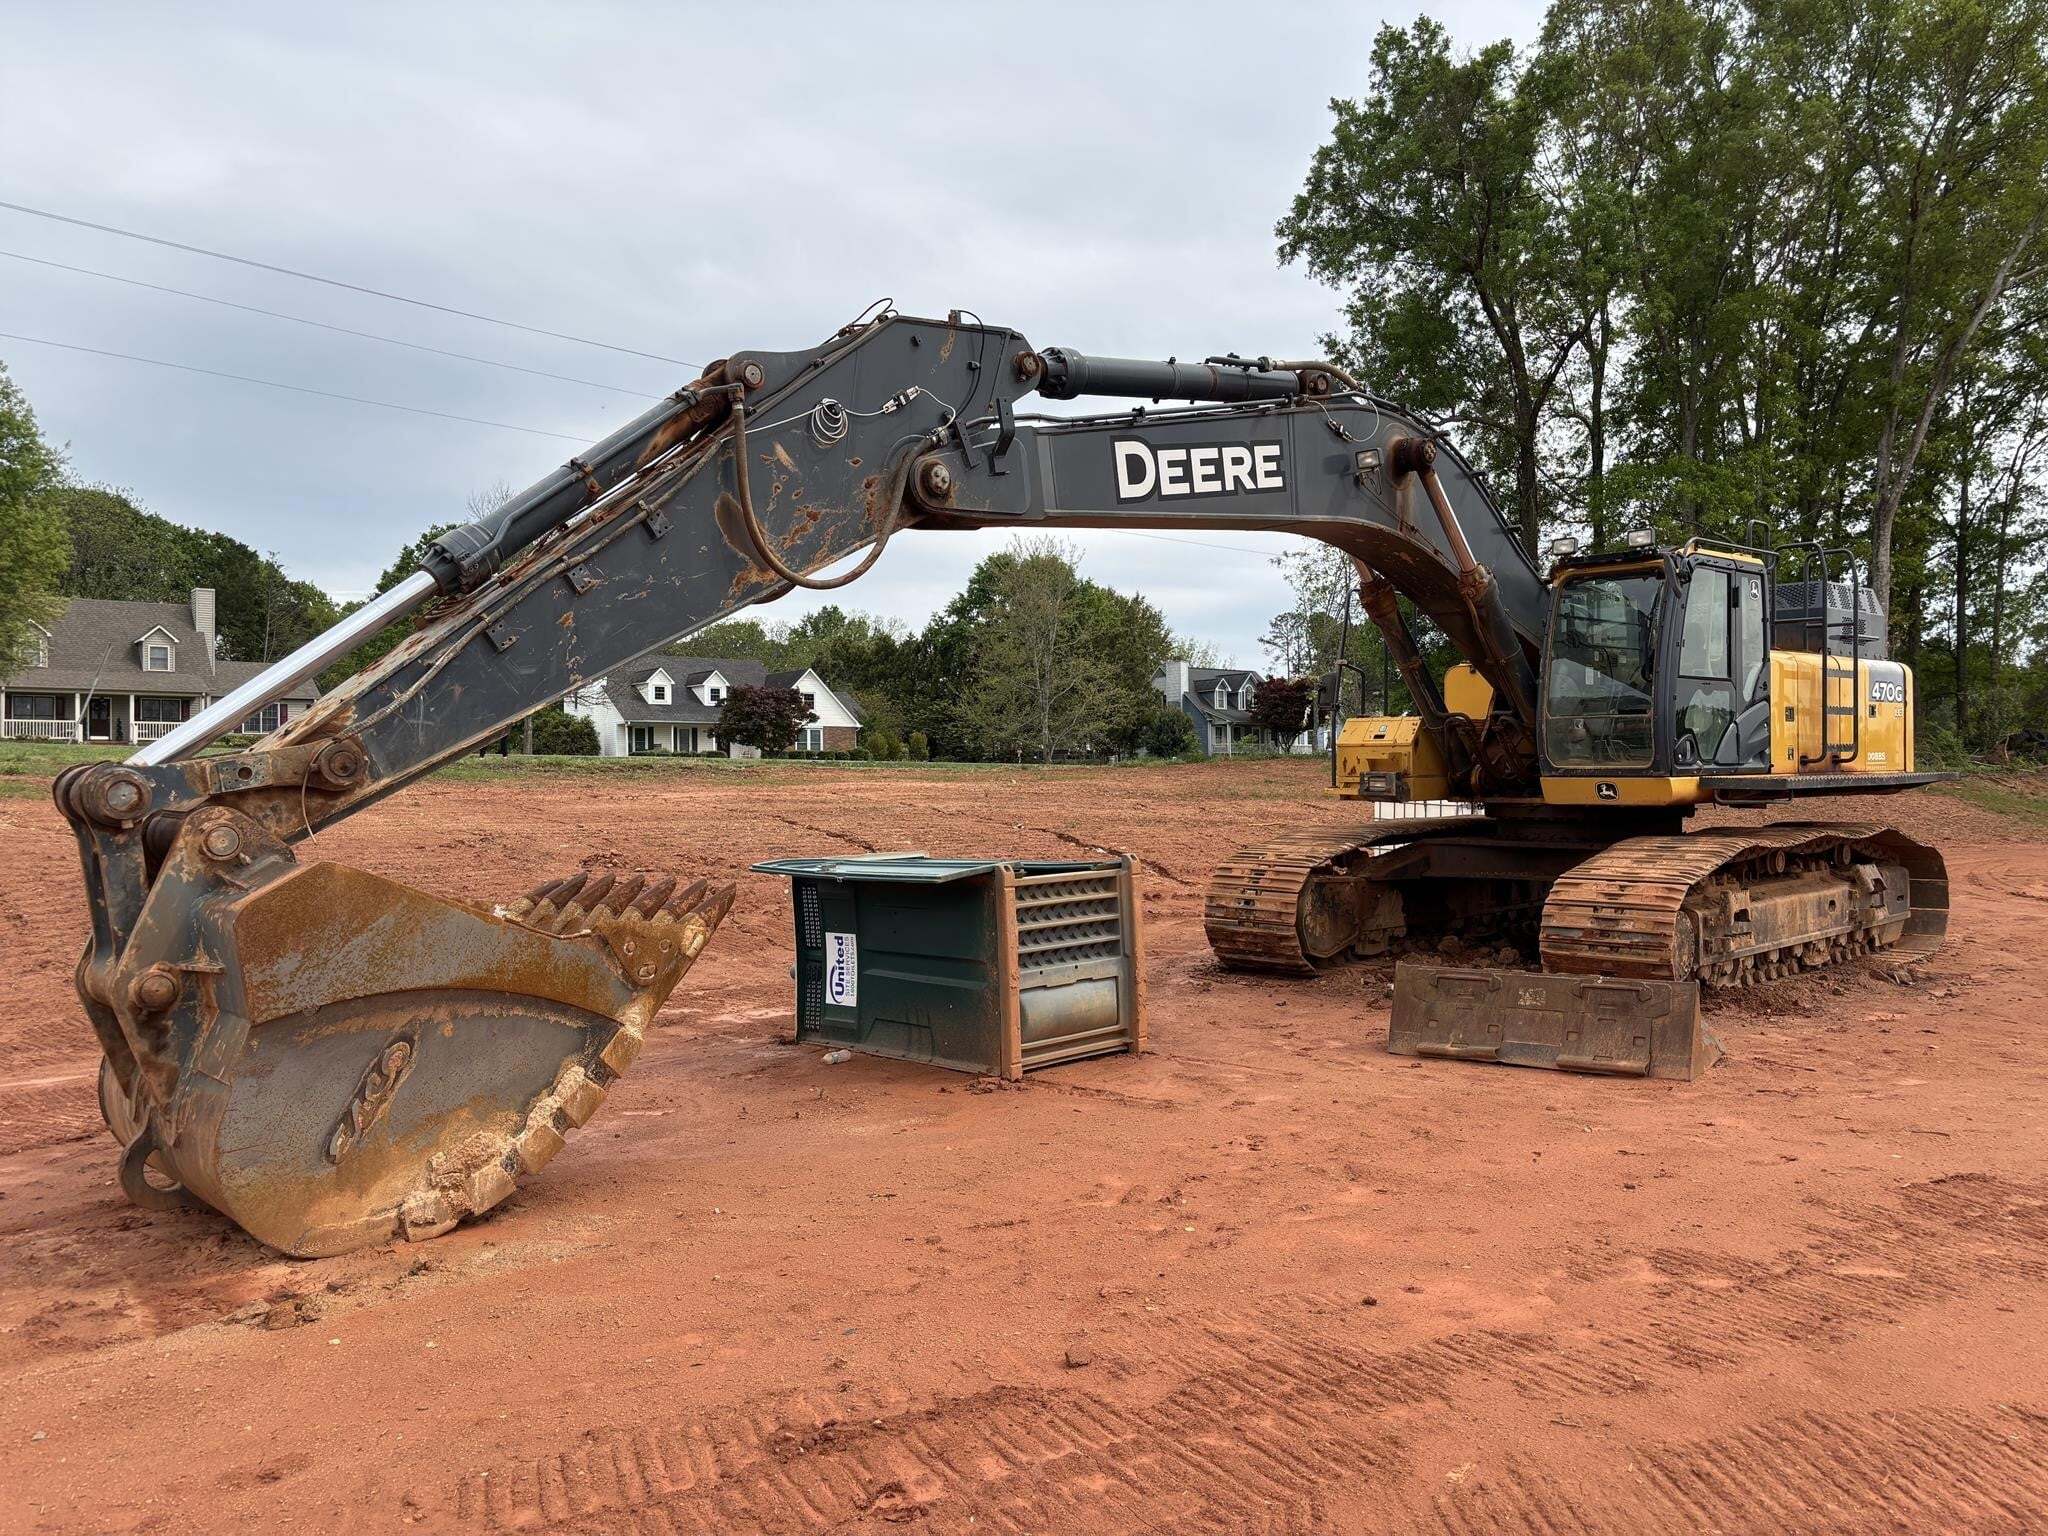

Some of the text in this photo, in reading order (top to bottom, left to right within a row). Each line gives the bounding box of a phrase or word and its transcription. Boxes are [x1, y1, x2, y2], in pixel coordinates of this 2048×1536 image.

[1114, 440, 1284, 499] DEERE
[1872, 681, 1903, 702] 470G
[834, 935, 845, 997] United
